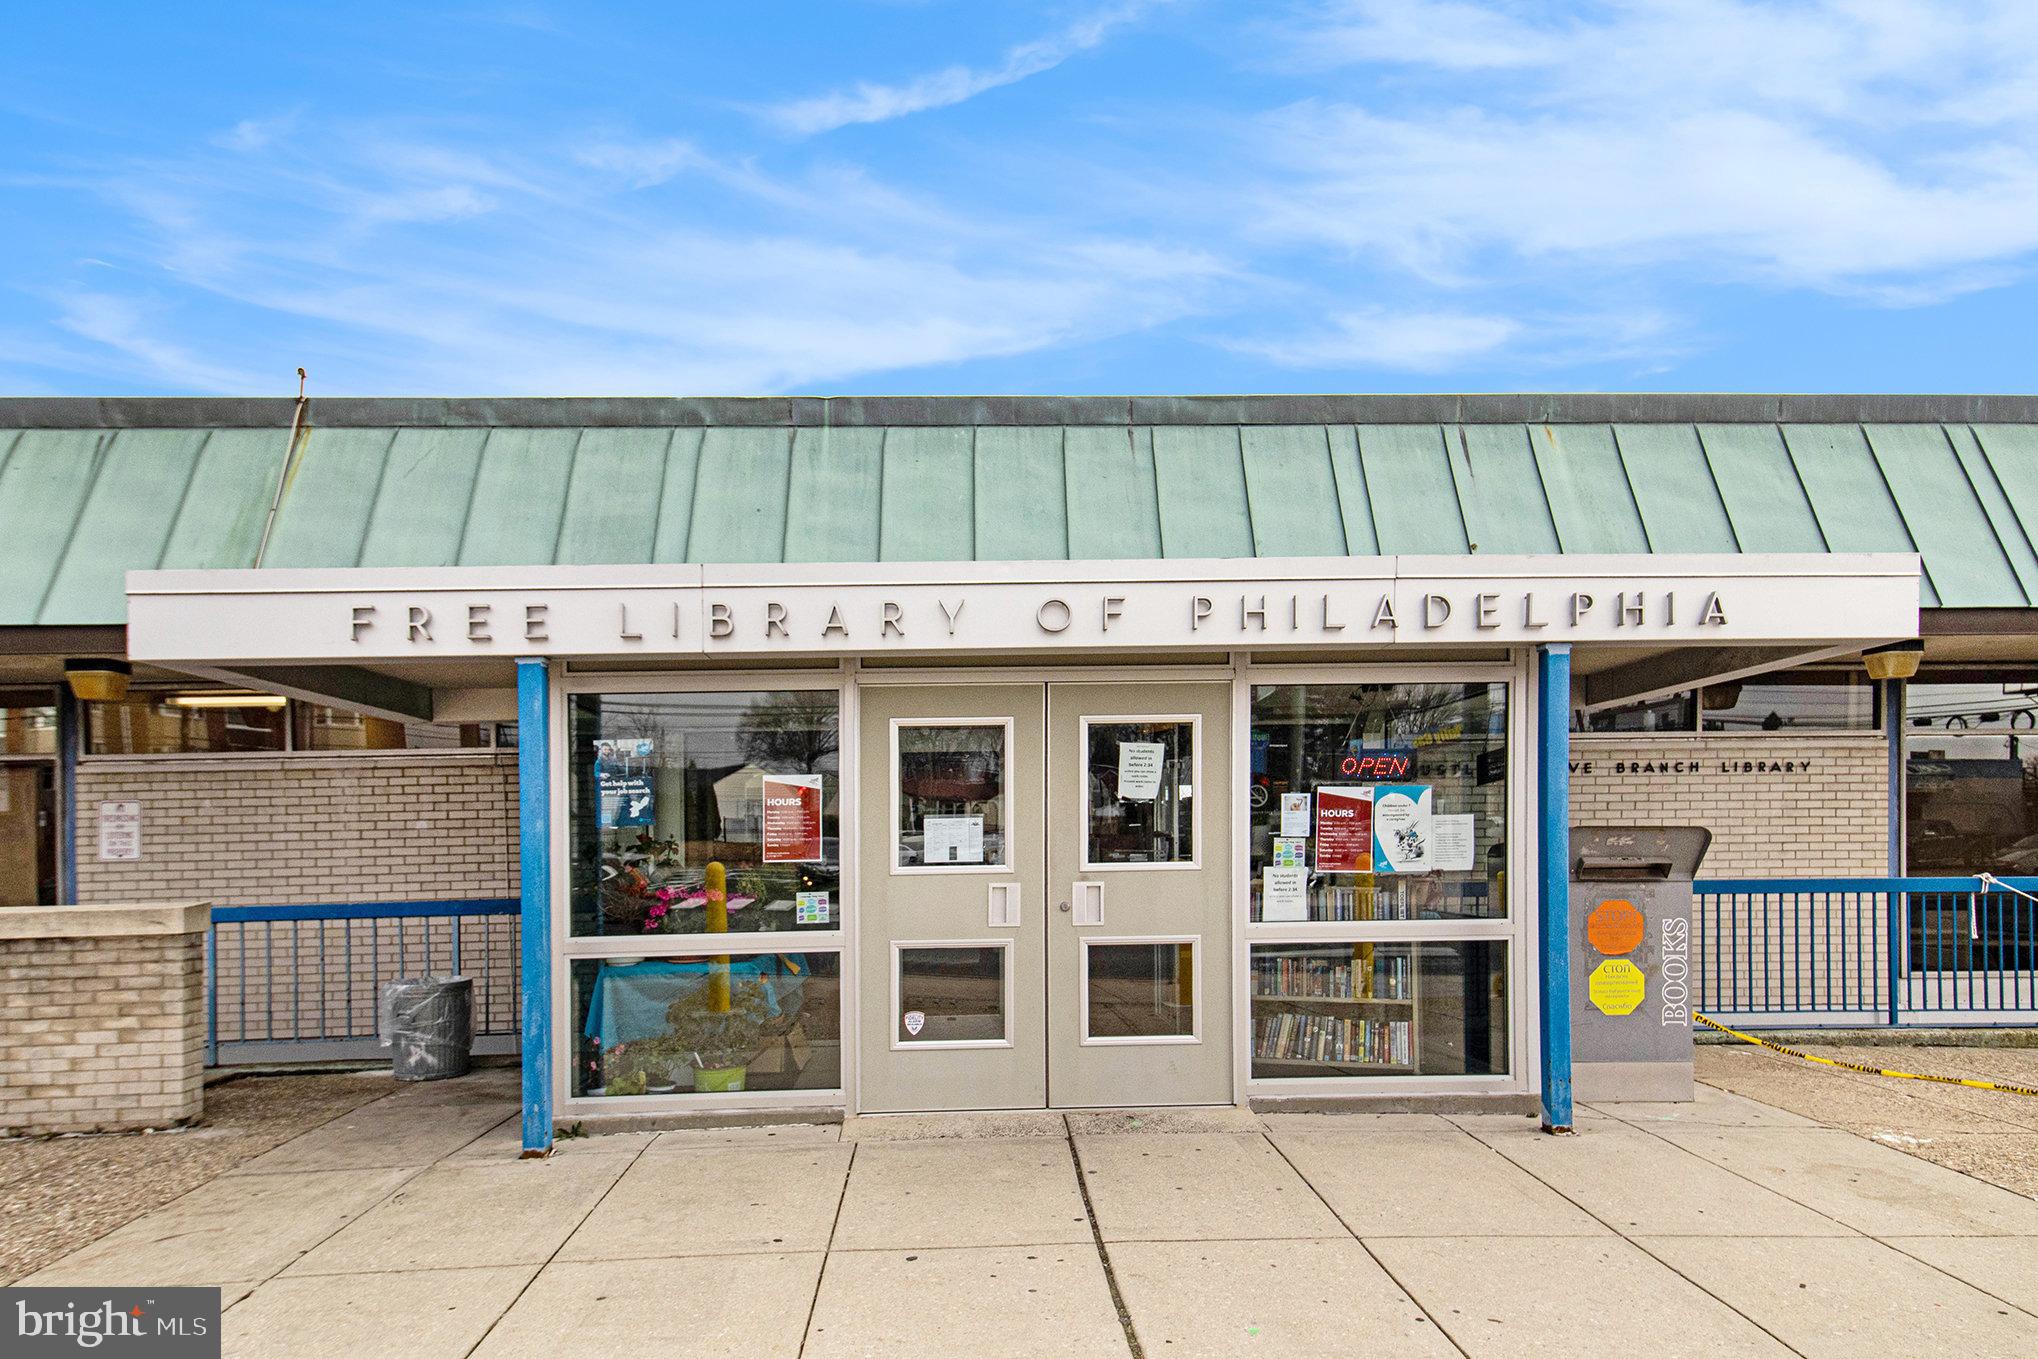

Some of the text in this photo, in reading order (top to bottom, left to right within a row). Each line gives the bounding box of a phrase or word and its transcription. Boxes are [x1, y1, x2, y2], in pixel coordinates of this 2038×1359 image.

[349, 590, 1730, 641] FREE LIBRARY OF PHILADELPHIA
[1341, 756, 1410, 776] OPEN
[1616, 762, 1700, 774] BRANCH
[1721, 761, 1812, 773] LIBRARY
[613, 779, 627, 788] help
[601, 789, 617, 797] your
[617, 788, 628, 796] job
[766, 798, 802, 807] HOURS
[1320, 809, 1354, 818] HOURS
[1661, 917, 1689, 1026] BOOKS
